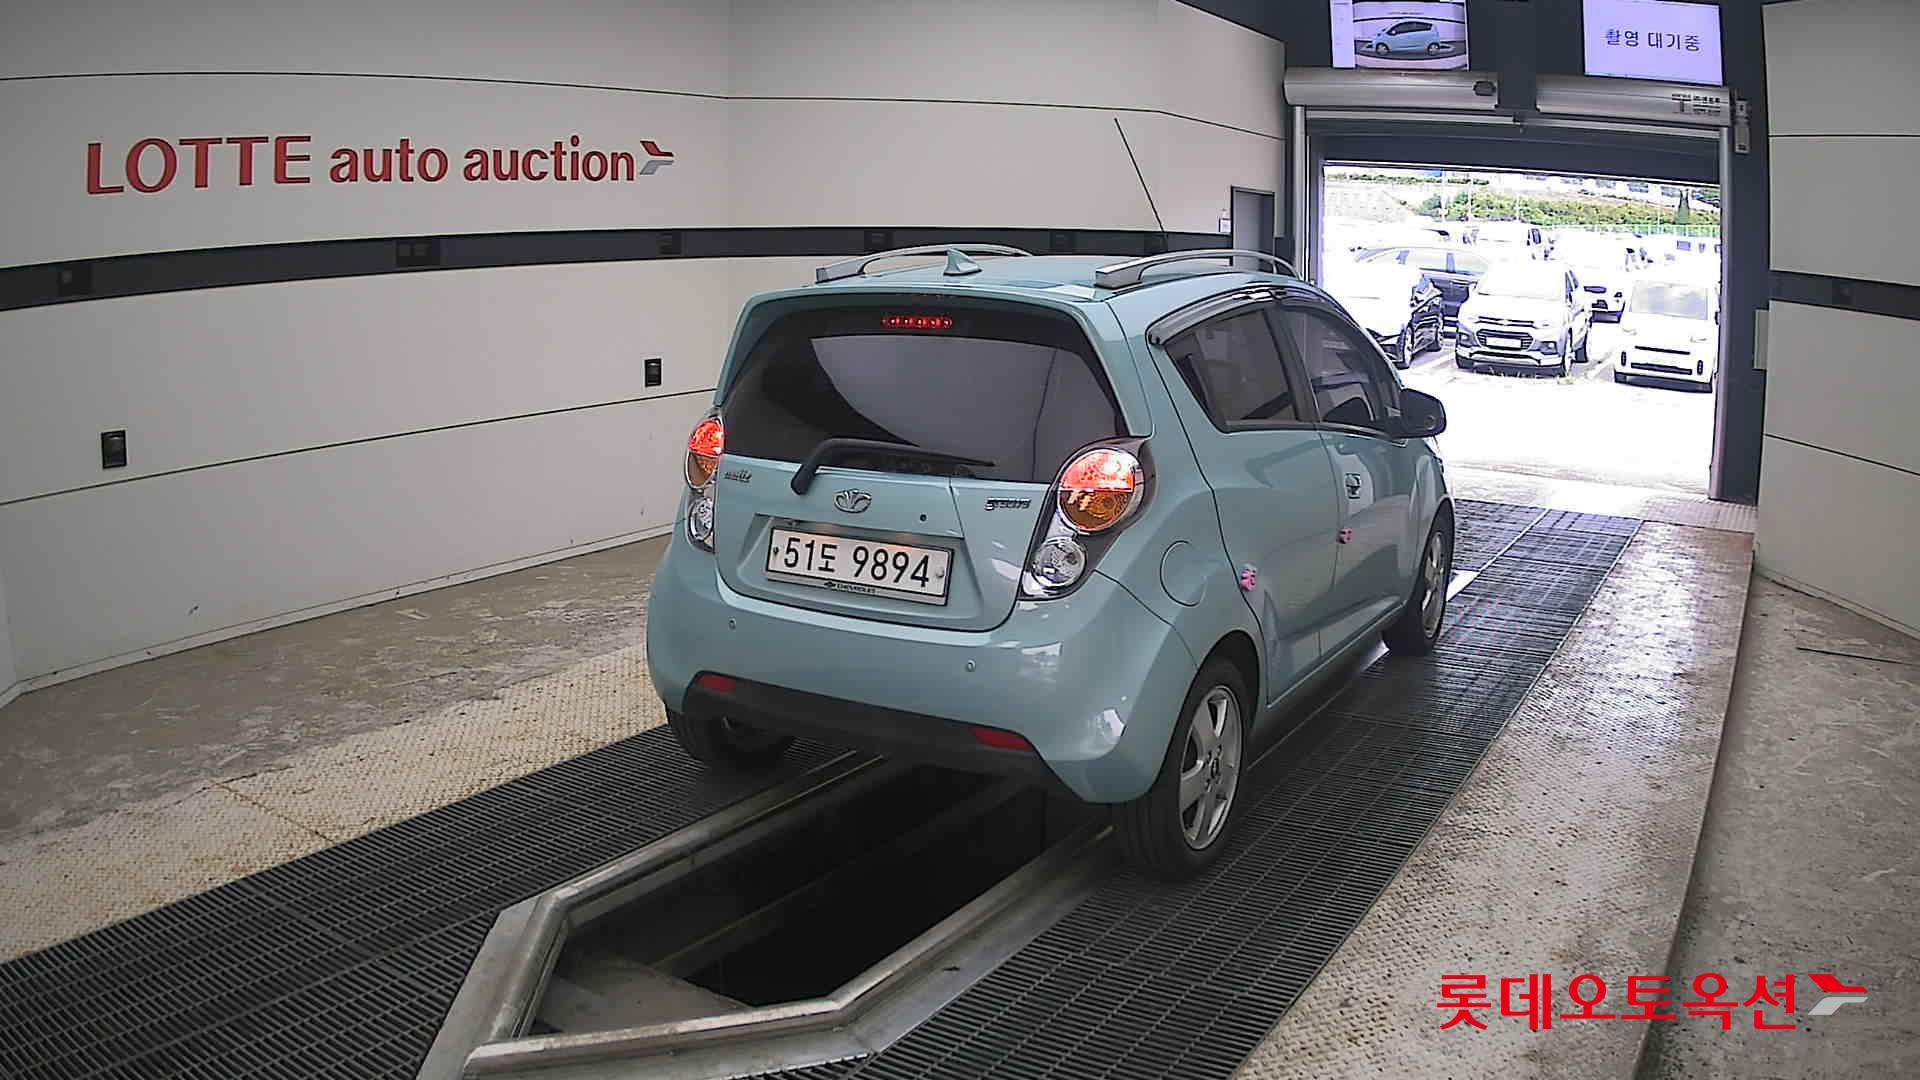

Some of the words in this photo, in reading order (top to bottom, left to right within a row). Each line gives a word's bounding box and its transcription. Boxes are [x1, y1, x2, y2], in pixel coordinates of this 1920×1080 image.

[1648, 32, 1701, 52] 대기중
[87, 136, 312, 194] LOTTE
[329, 138, 449, 182] auto
[464, 135, 636, 181] auction
[783, 537, 838, 573] 51도
[852, 545, 930, 588] 9894
